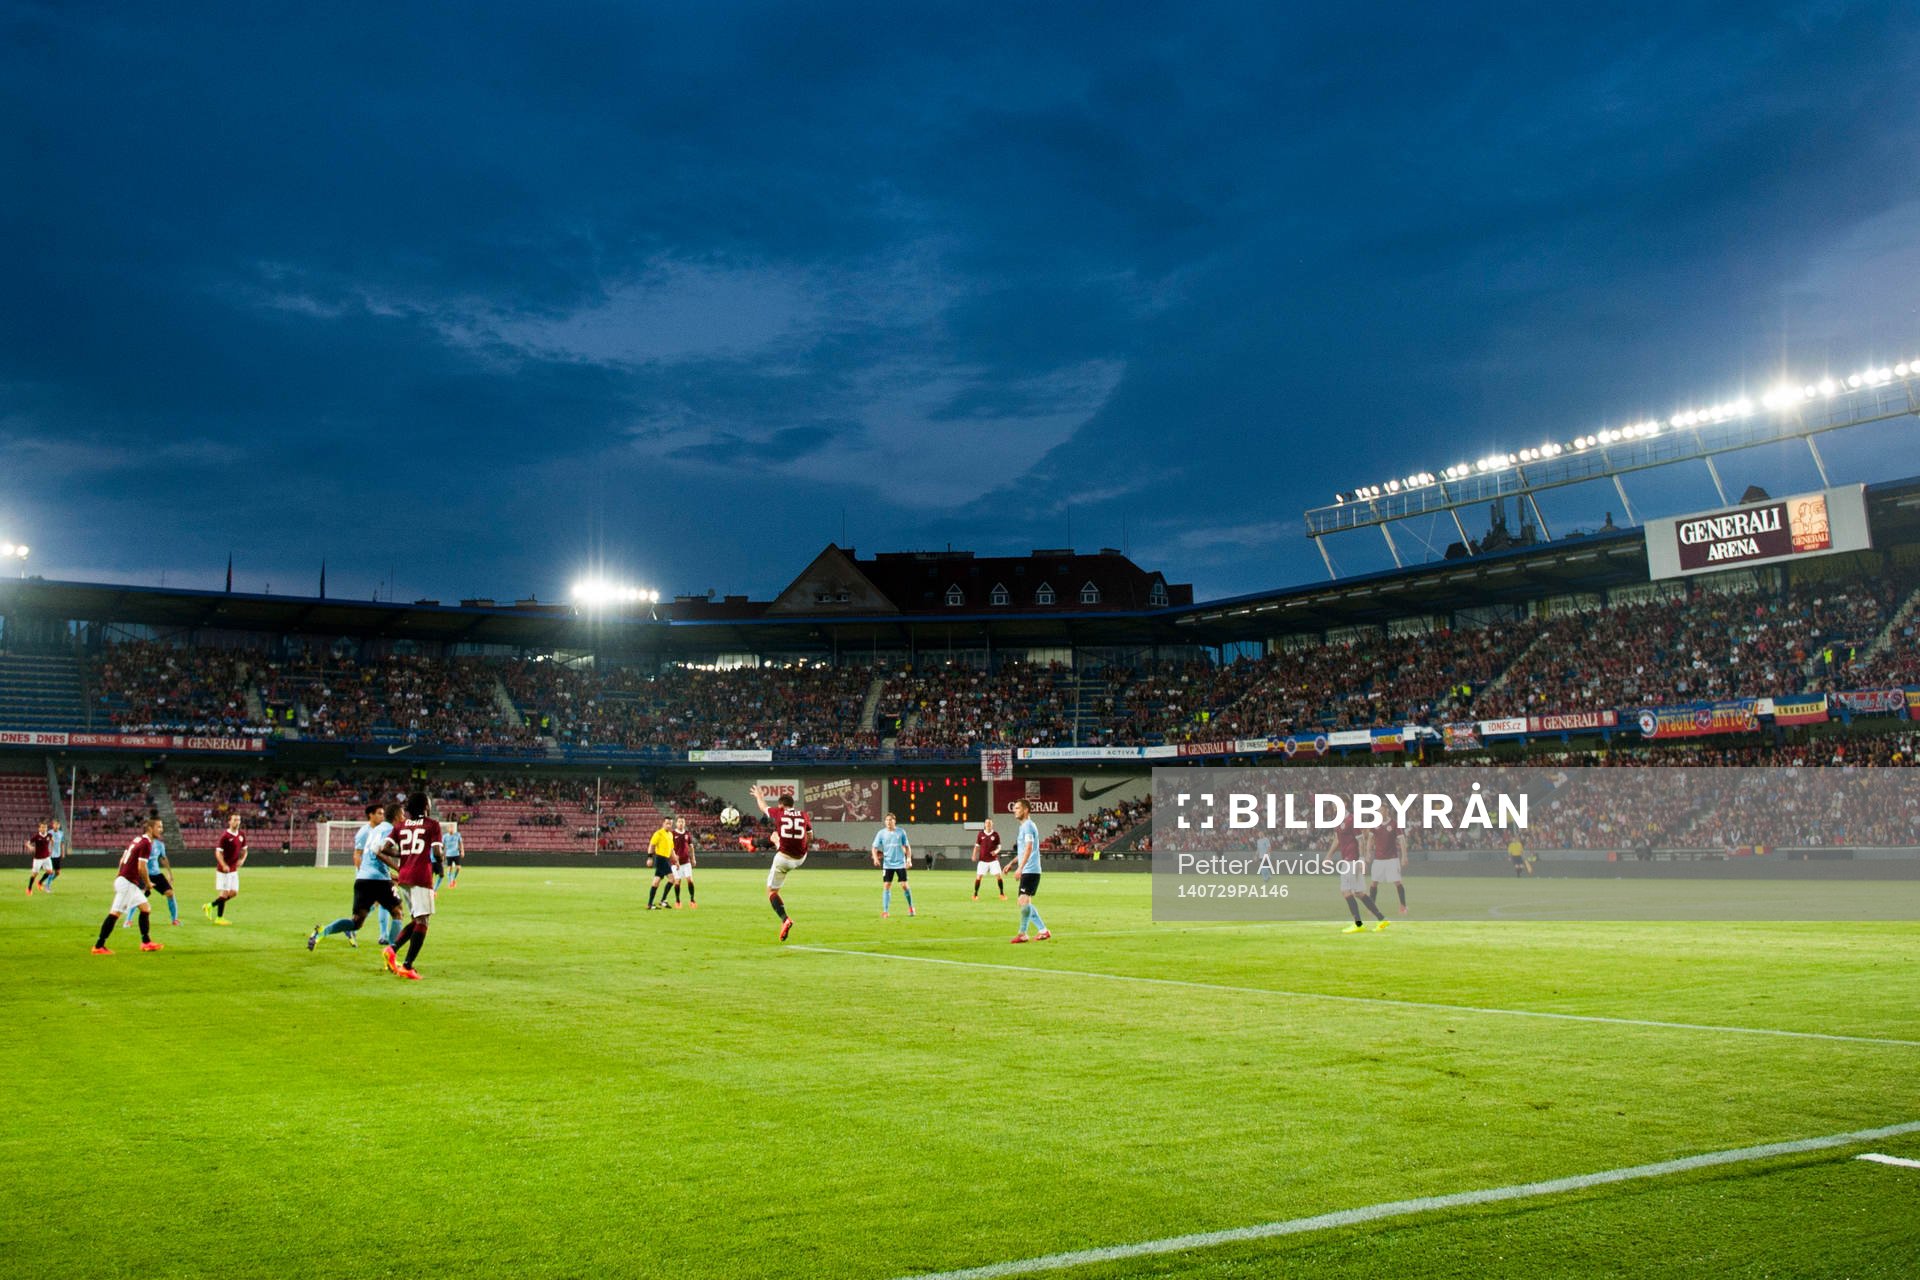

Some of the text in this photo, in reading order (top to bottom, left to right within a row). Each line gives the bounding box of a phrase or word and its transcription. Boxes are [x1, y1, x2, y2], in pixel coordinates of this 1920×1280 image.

[1680, 507, 1782, 545] GENERALI
[1791, 532, 1829, 546] GENERALI
[1707, 538, 1761, 561] ARENA
[1778, 704, 1821, 714] LOVOSICE
[1543, 712, 1599, 730] GENERALI
[2, 733, 31, 743] DNES
[36, 734, 65, 744] DNES
[187, 738, 247, 750] GENERALI
[1188, 742, 1224, 755] GENERALI
[1007, 801, 1059, 812] GERALI
[780, 817, 805, 839] 25
[400, 828, 425, 855] 26
